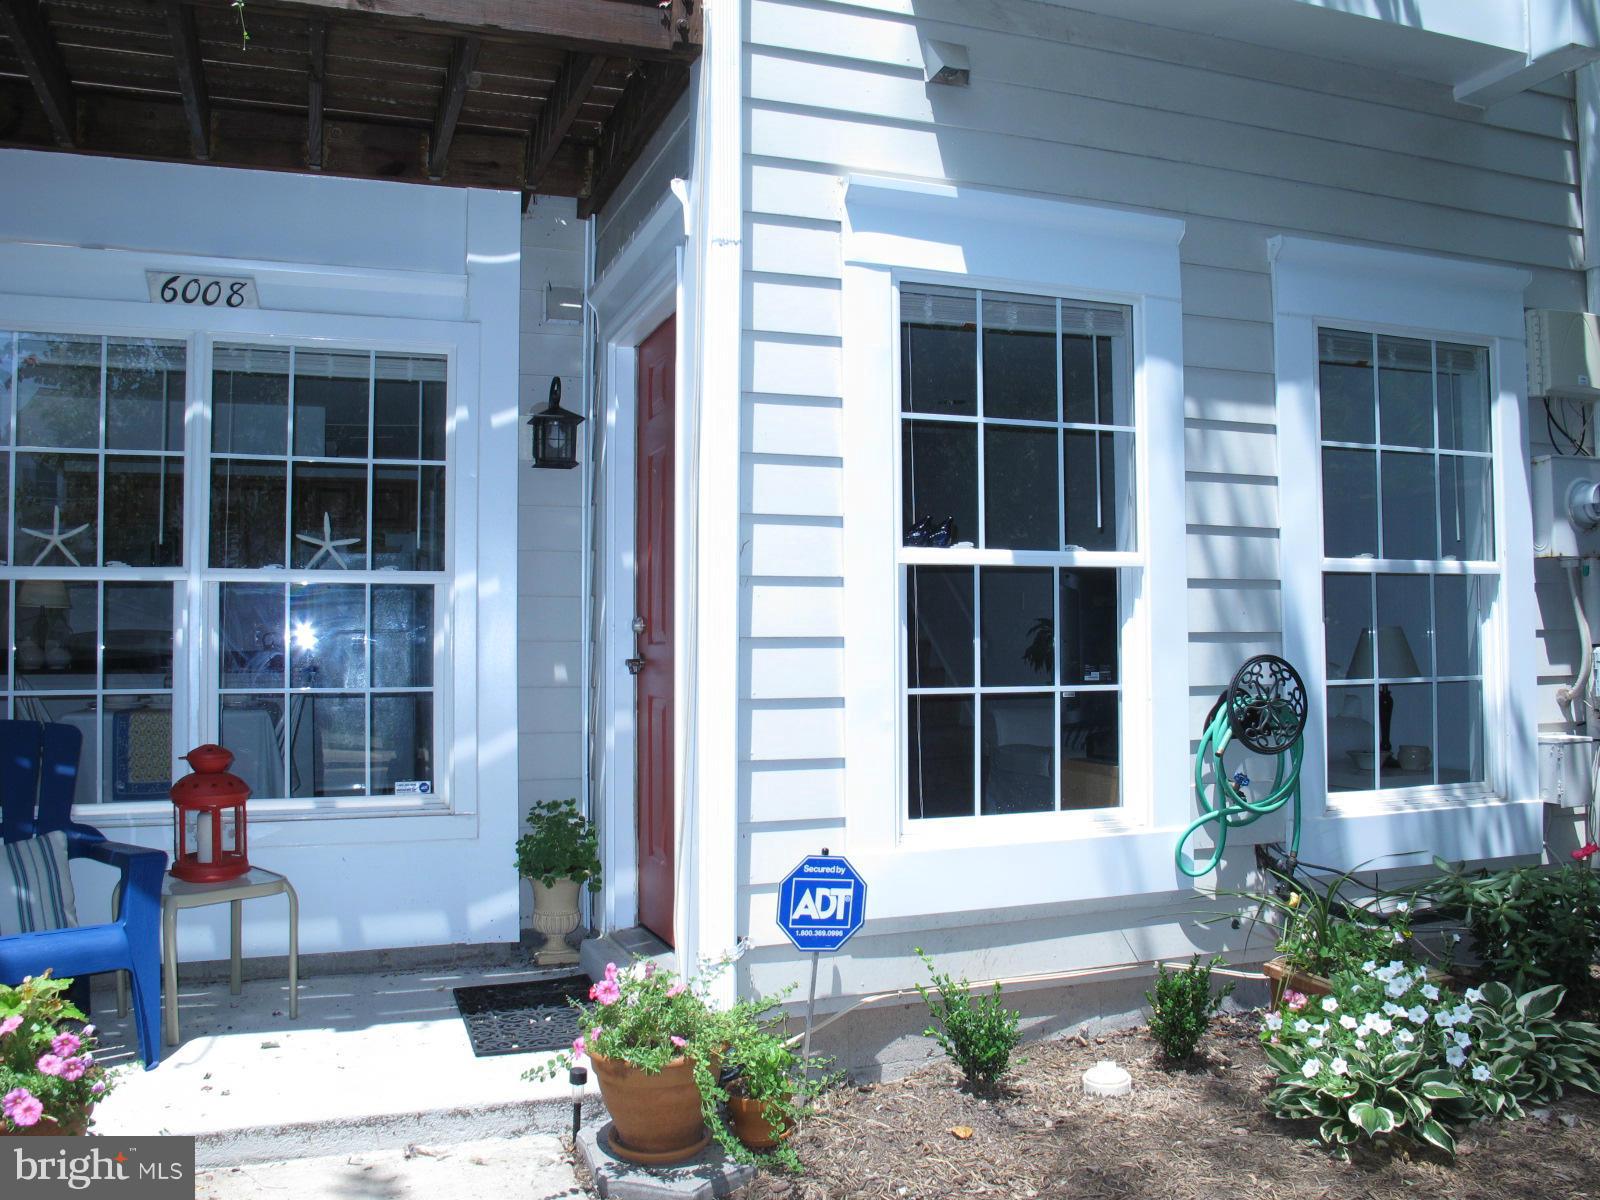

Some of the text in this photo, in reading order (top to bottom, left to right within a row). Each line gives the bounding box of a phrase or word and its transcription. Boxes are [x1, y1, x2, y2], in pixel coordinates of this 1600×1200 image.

[161, 275, 247, 308] 6008
[803, 864, 846, 875] Secured by
[791, 887, 852, 920] ADT
